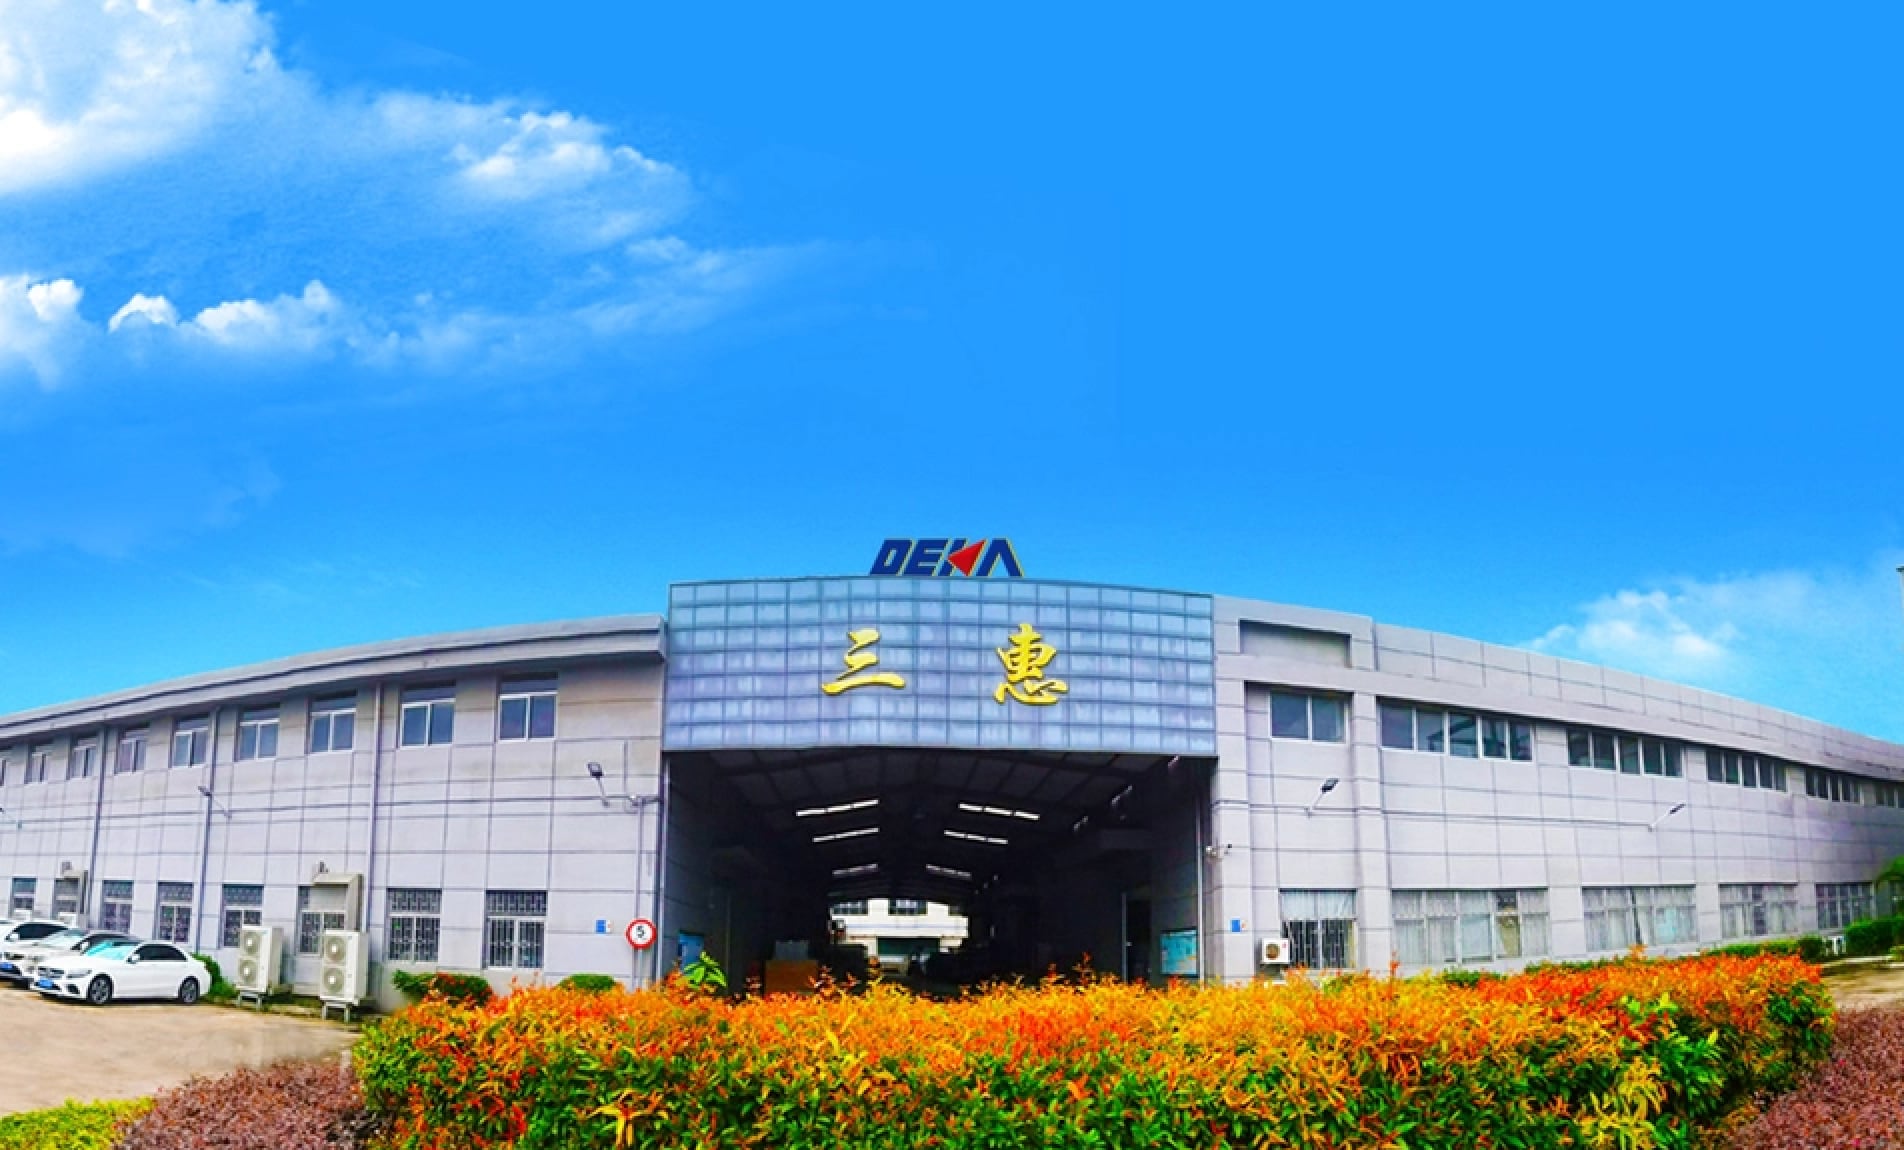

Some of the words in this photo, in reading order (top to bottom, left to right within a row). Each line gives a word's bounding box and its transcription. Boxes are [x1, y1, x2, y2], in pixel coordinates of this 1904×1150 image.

[870, 538, 1024, 576] DEKA
[822, 623, 1069, 706] 三惠
[636, 925, 645, 938] 5
